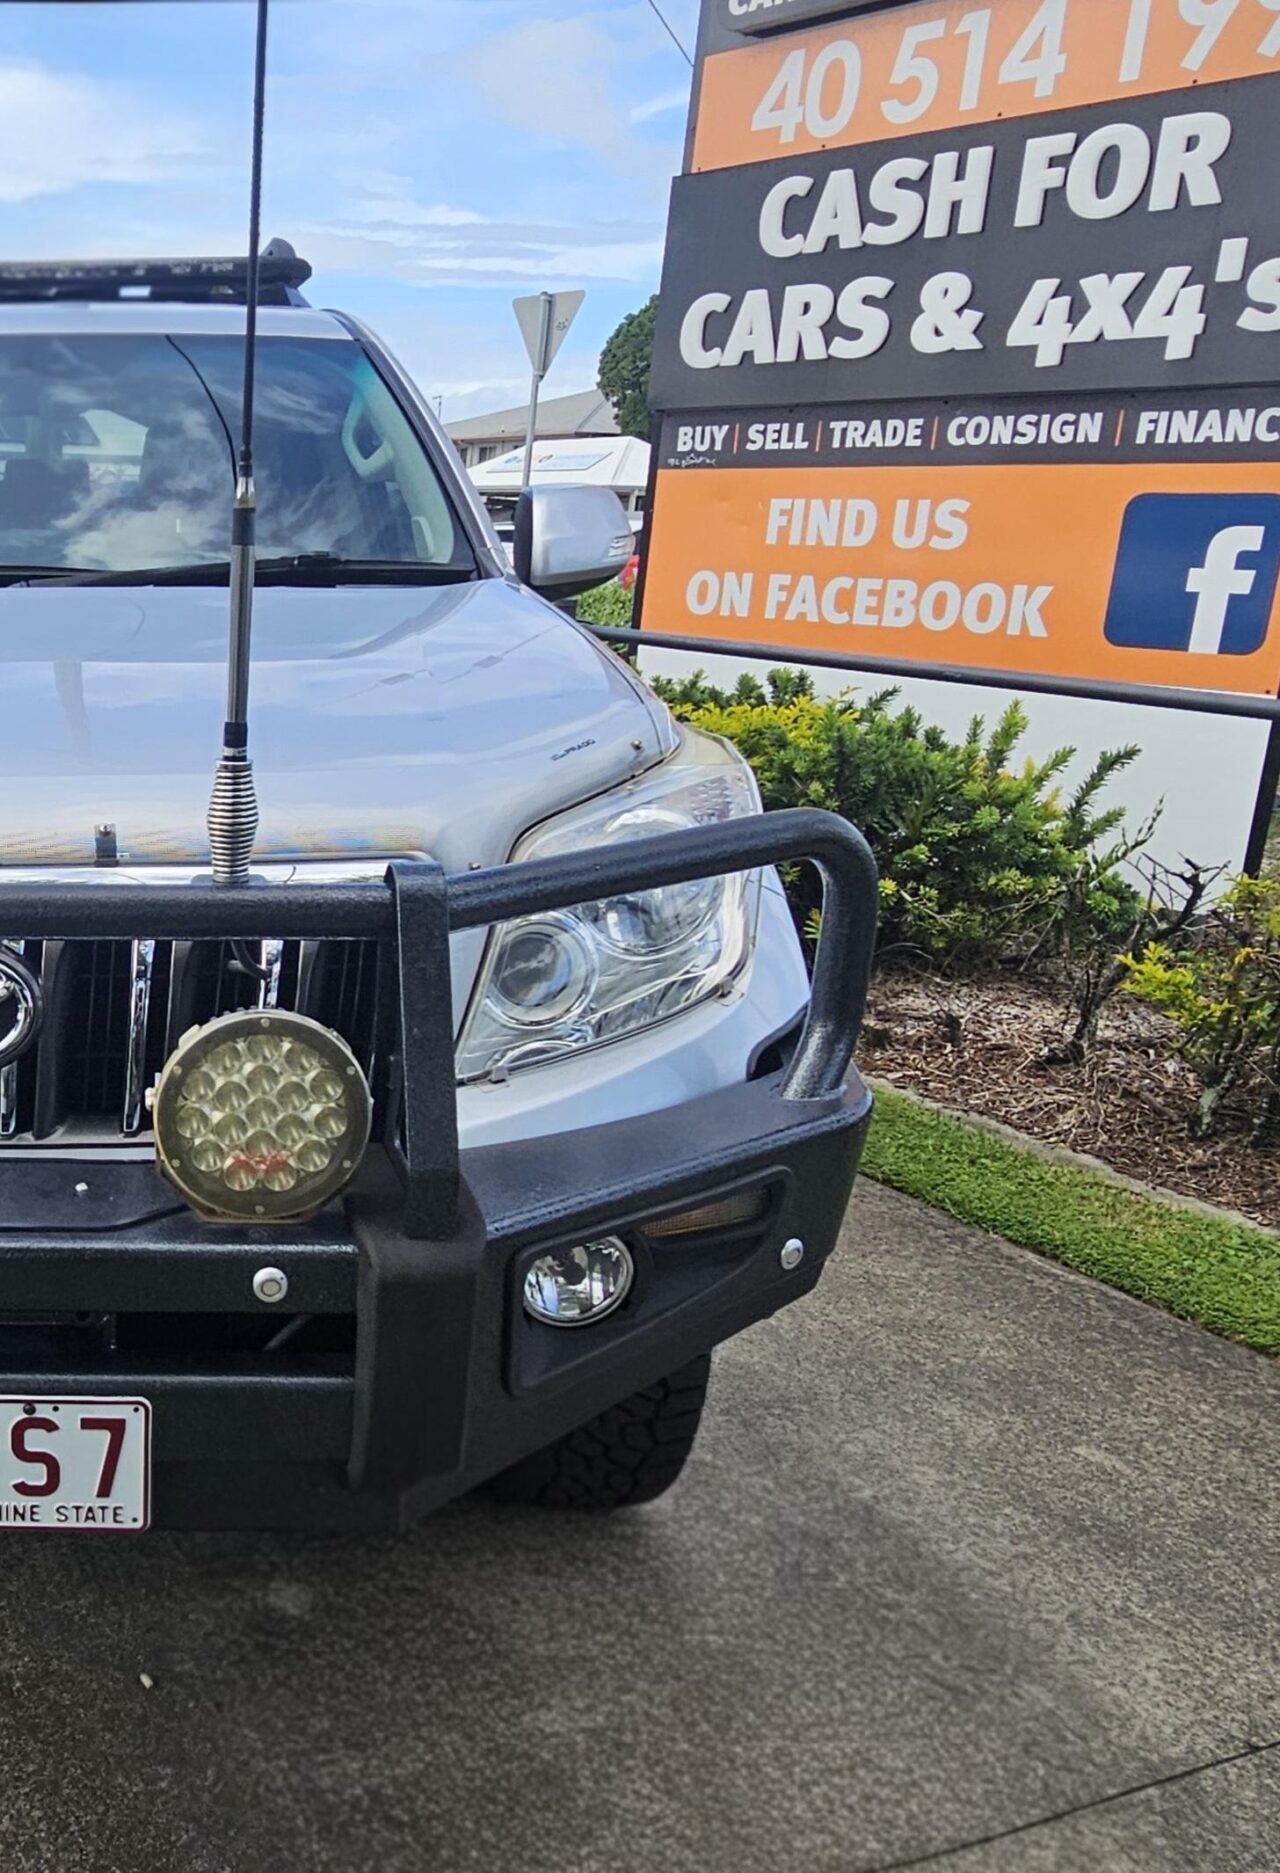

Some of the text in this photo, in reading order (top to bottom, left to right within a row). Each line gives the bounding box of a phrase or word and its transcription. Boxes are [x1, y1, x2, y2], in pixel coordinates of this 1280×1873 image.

[750, 40, 861, 143] 40
[881, 0, 1067, 123] 514
[760, 112, 1230, 257] CASH FOR
[680, 276, 893, 368] CARS
[910, 272, 982, 353] &
[677, 408, 1280, 451] BUY SELL TRADE CONSIGN FINANC
[765, 499, 971, 549] FIND US
[686, 571, 1053, 636] ON FACEBOOK
[55, 1504, 125, 1526] STATE
